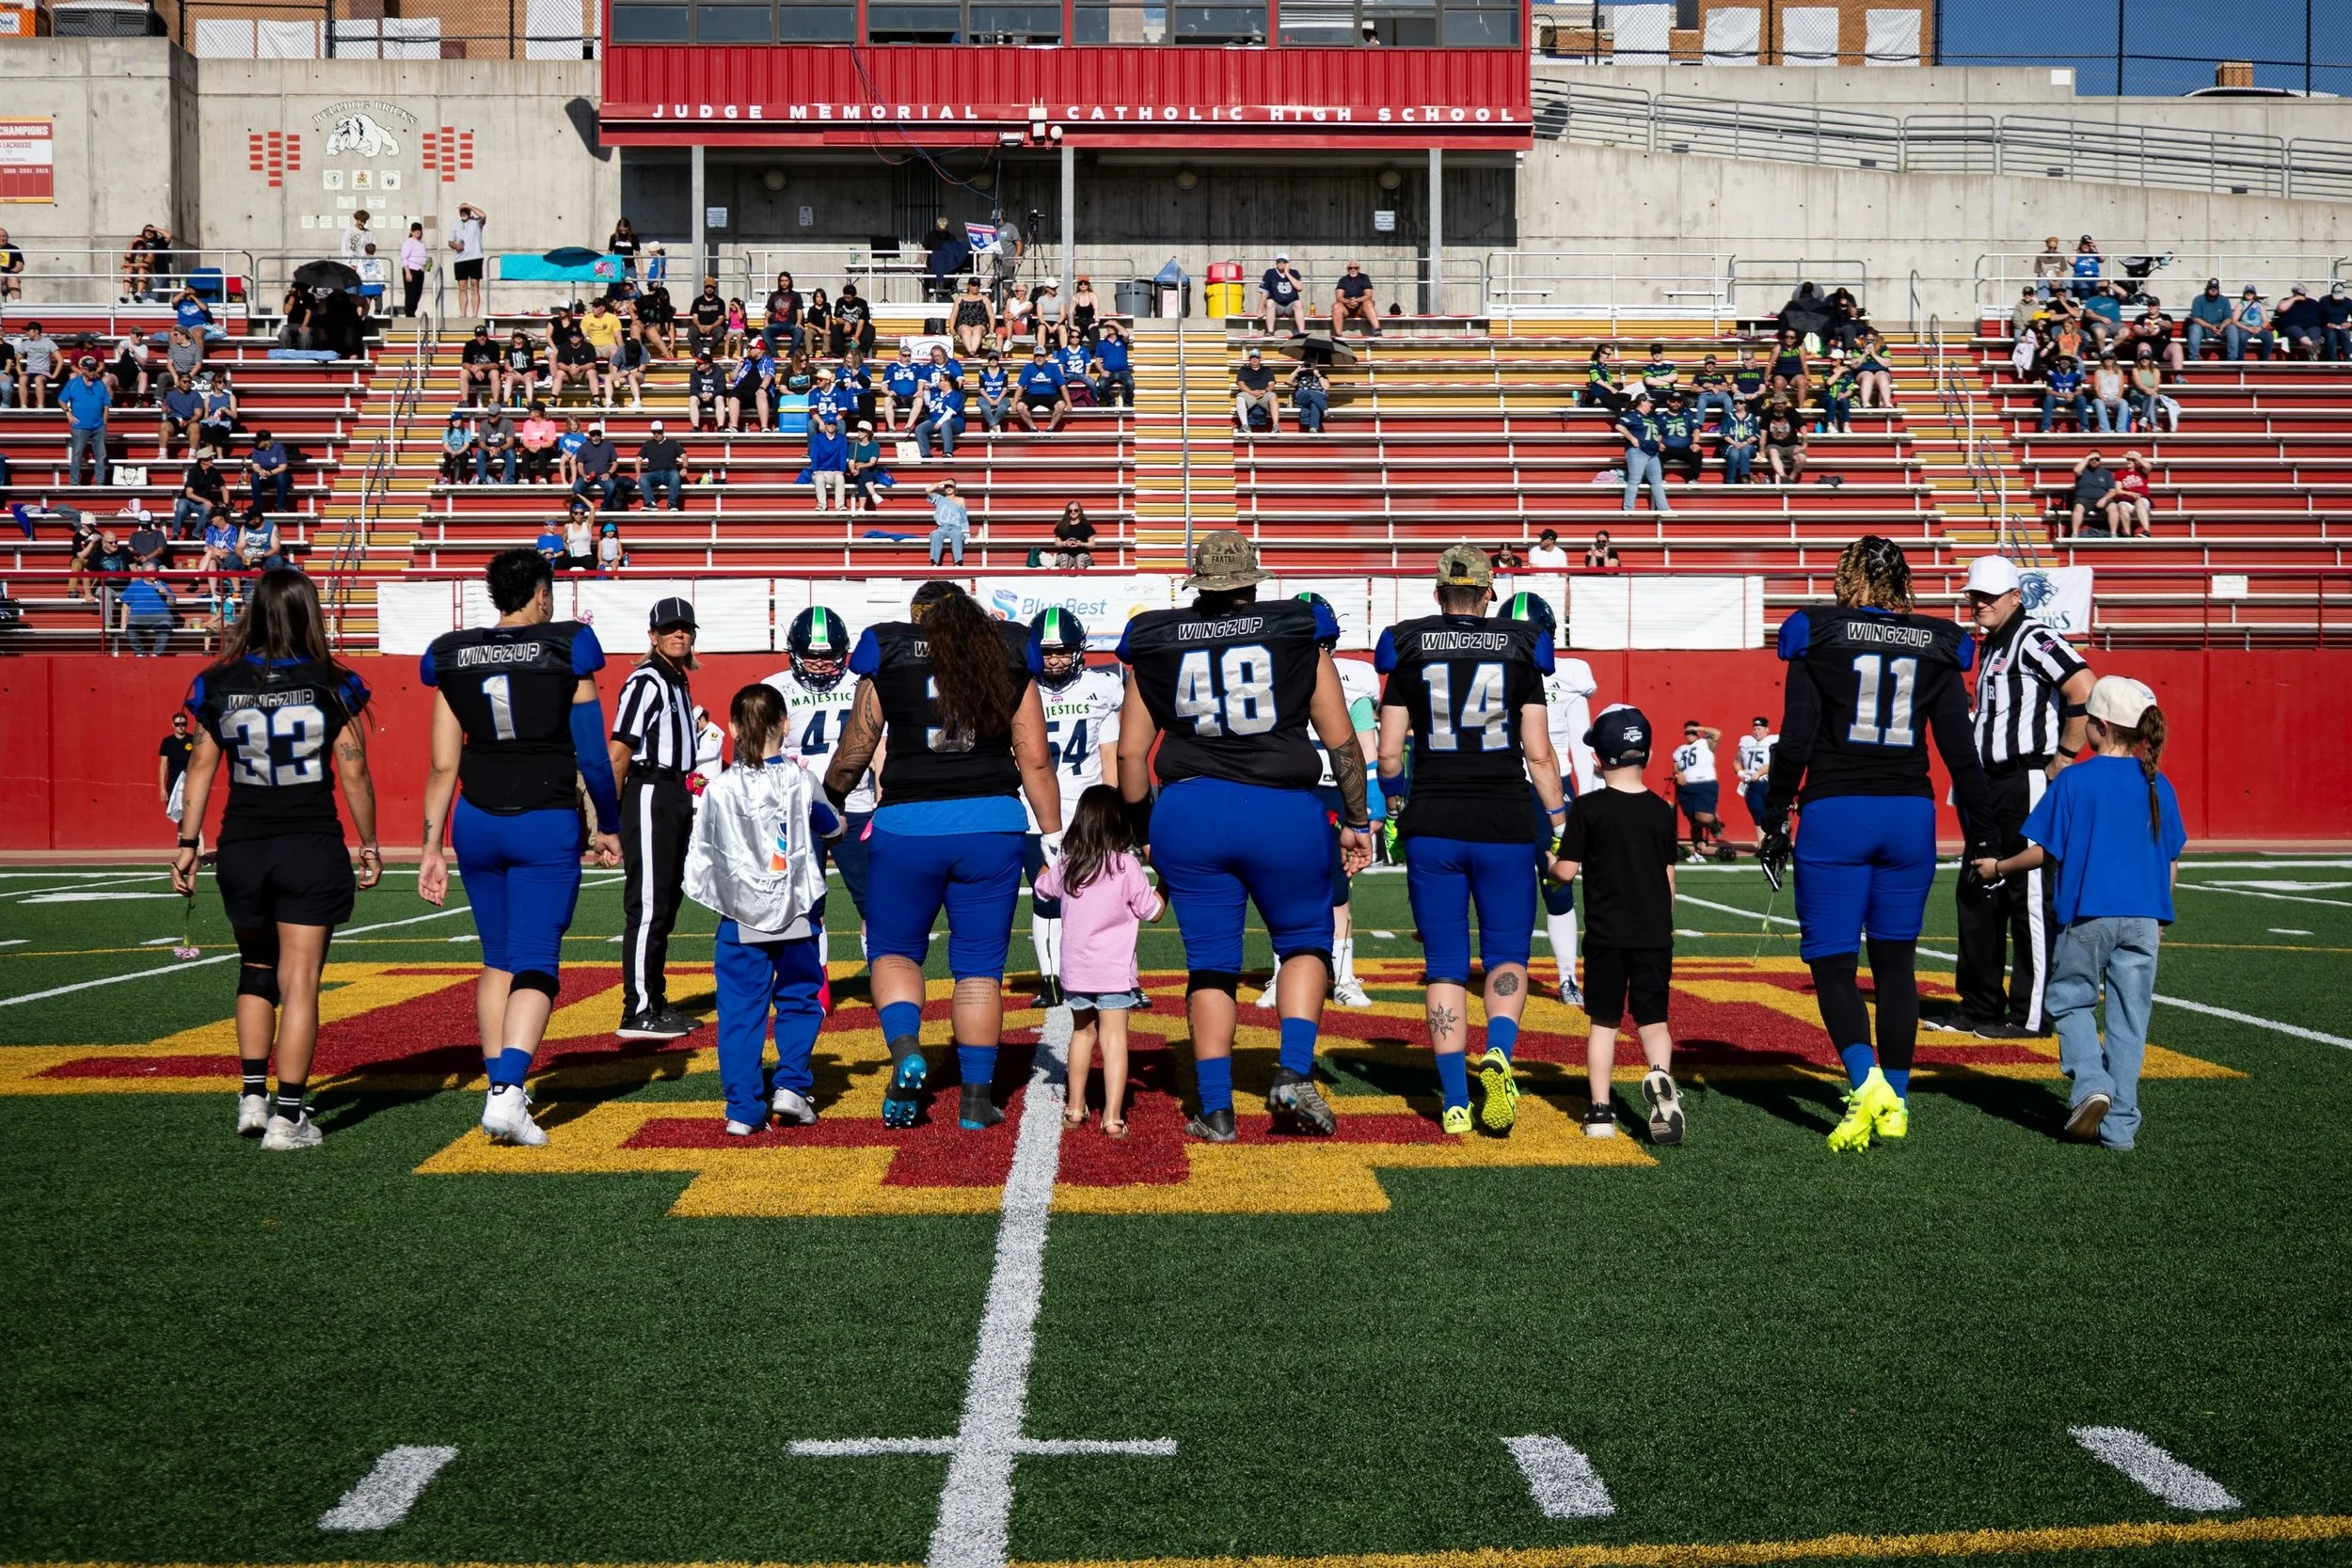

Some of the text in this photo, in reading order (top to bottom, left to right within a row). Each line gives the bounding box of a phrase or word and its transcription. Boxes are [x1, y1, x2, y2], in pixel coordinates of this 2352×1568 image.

[311, 100, 418, 125] BULLDOG BRICKS
[652, 104, 1515, 123] JUDGE MEMORIAL CATHOLIC HIGH SCHOOL
[1067, 359, 1085, 374] 32
[1665, 422, 1687, 437] 75
[1178, 616, 1263, 641] WINGZUP
[1422, 631, 1508, 651] WINGZUP
[1847, 622, 1932, 647] WINGZUP
[457, 642, 540, 667] WINGZUP
[229, 689, 315, 709] WINGZUP
[790, 692, 853, 707] MAJESTIC
[1175, 644, 1278, 737] 48
[1847, 653, 1917, 747] 11
[1988, 684, 1995, 700] R
[481, 673, 517, 741] 1
[671, 702, 677, 712] S
[1045, 704, 1090, 719] JESTICS
[1422, 661, 1511, 752] 14
[218, 705, 325, 786] 33
[1045, 719, 1090, 776] 54
